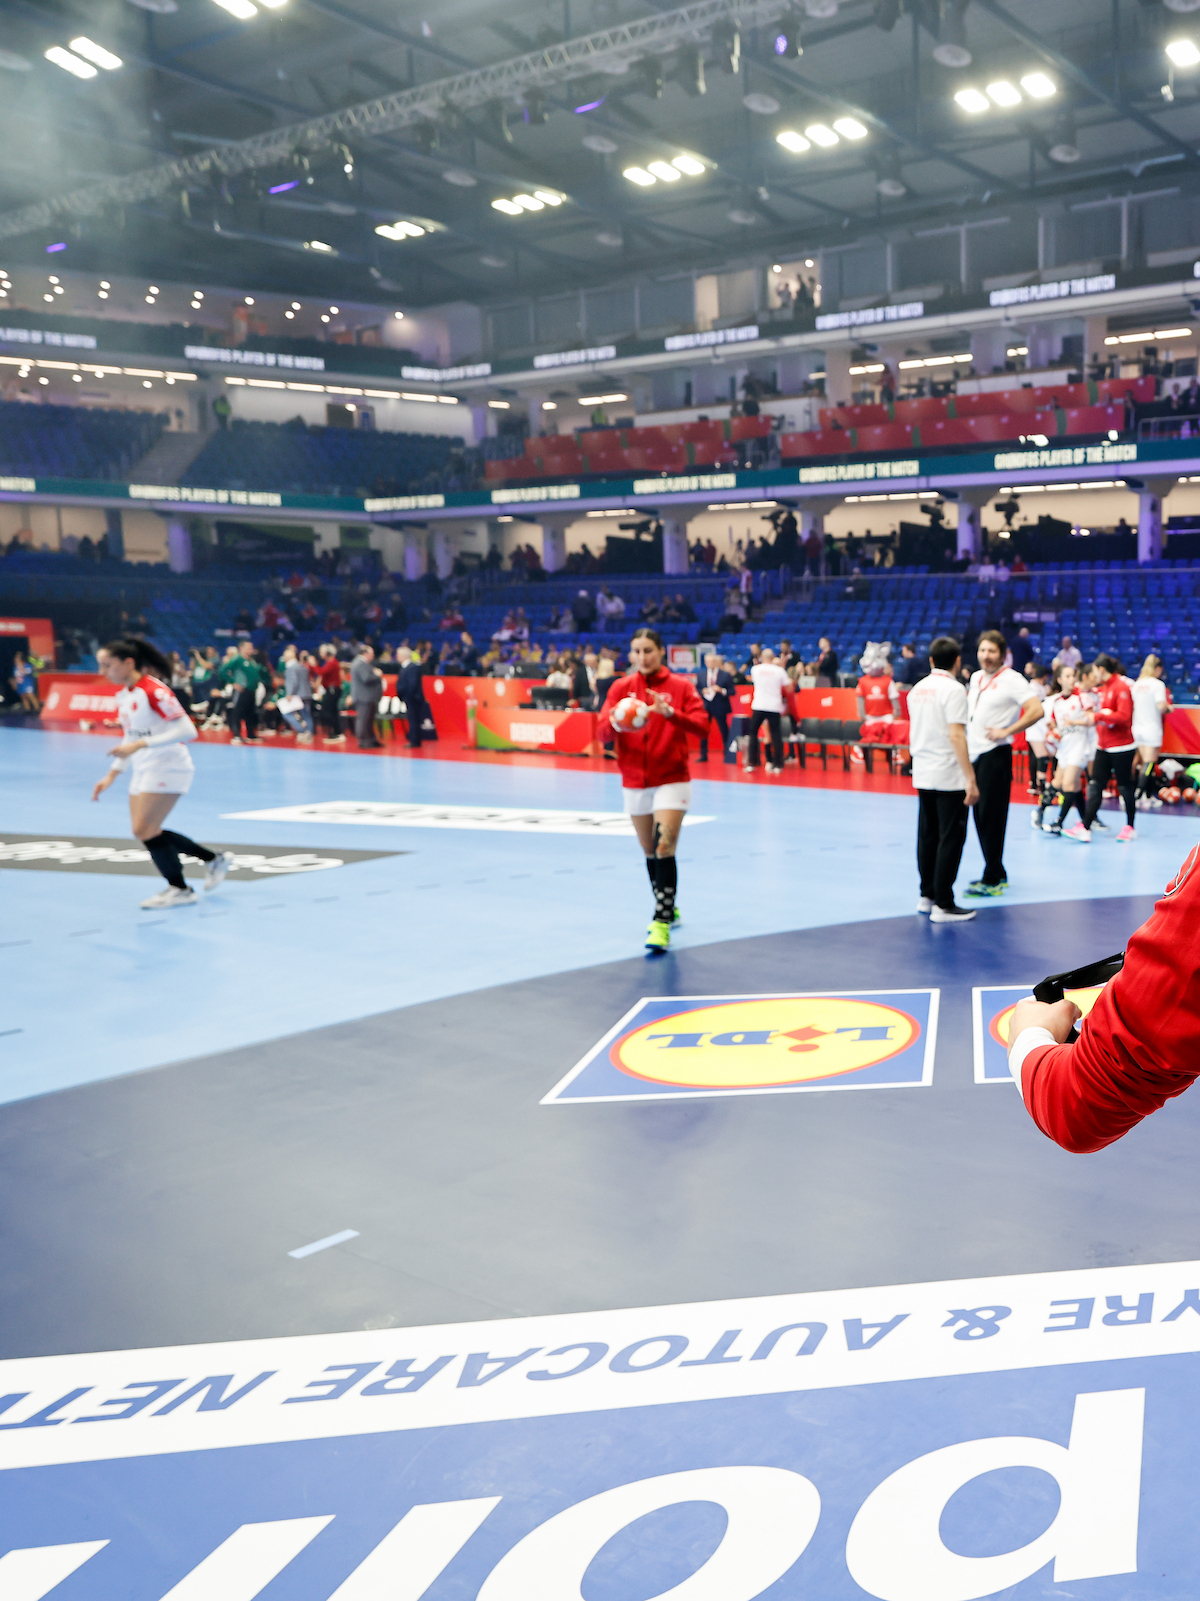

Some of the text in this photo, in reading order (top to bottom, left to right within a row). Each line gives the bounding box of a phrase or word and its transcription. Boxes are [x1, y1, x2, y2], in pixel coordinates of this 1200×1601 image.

[995, 444, 1136, 470] GRUNDFOS PLAYER OF THE MATCH
[940, 1305, 1013, 1342] &
[280, 1313, 911, 1405] AUTOCARE
